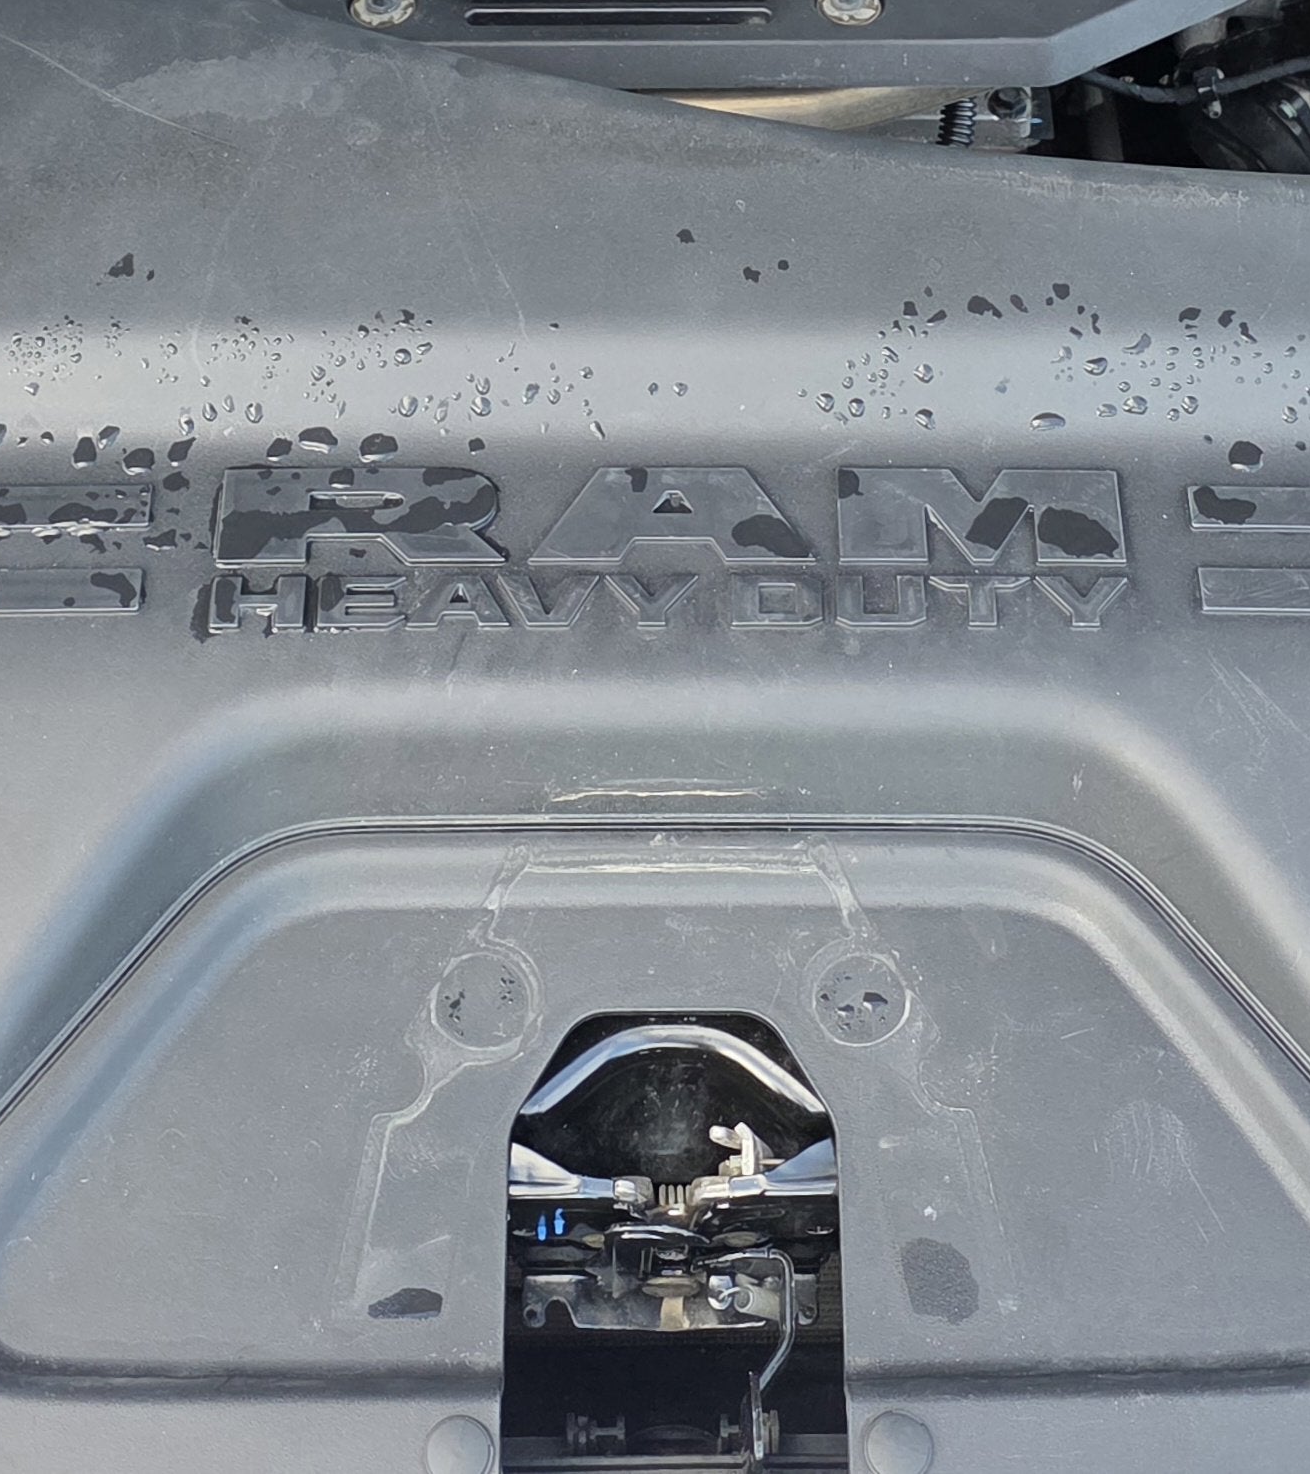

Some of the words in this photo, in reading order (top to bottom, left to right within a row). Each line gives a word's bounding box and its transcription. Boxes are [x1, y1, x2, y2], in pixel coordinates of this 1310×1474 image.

[211, 464, 1129, 568] RAM
[206, 573, 700, 635] HEAVY
[728, 573, 1130, 632] DUTY
